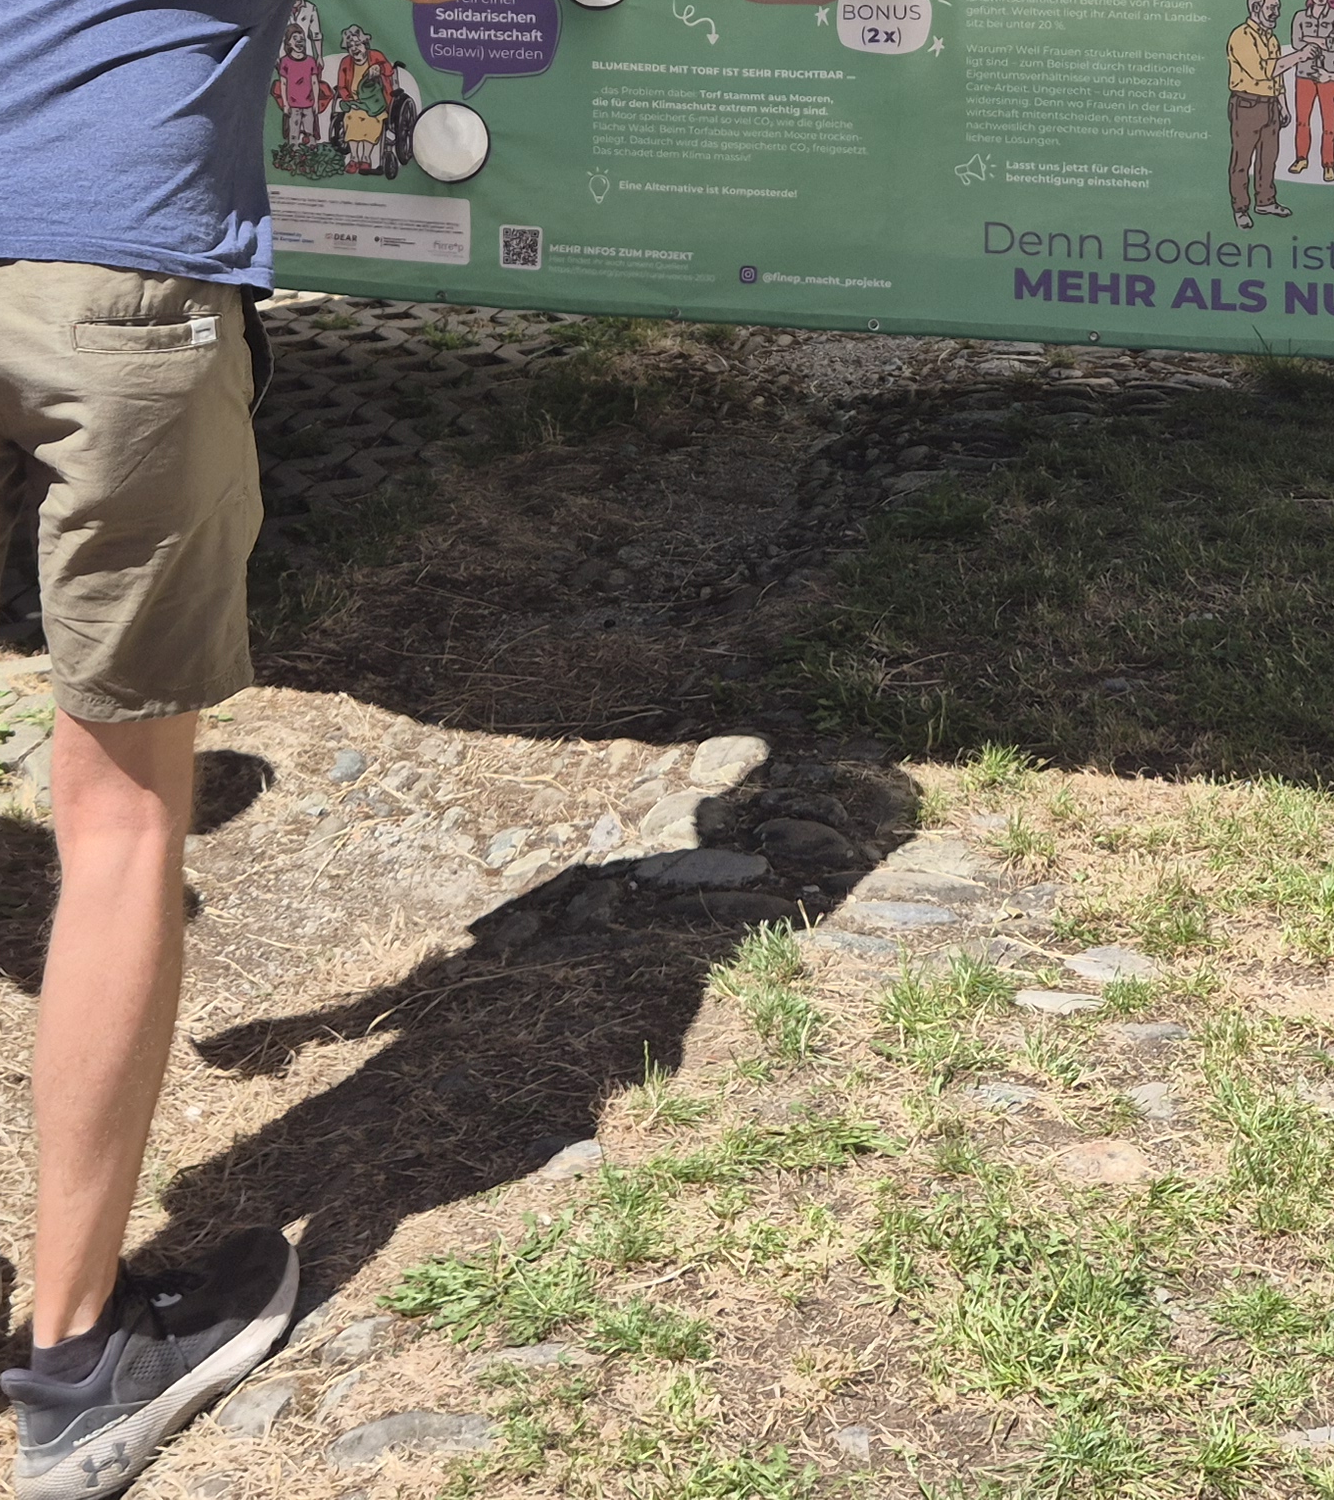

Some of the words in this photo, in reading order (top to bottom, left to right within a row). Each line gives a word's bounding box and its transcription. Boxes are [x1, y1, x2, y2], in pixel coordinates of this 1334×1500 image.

[435, 7, 536, 23] Solidarischen
[842, 3, 921, 20] BONUS
[429, 25, 543, 42] Landwirtschaft
[429, 43, 484, 60] (Solawi)
[487, 46, 543, 60] werden
[591, 60, 667, 73] BLUMENERDE
[668, 64, 689, 74] MIT
[690, 65, 720, 75] TORF
[722, 67, 739, 76] IST
[741, 67, 772, 78] SEHR
[774, 69, 844, 79] FRUCHTBAR
[698, 89, 722, 100] Torf
[723, 91, 766, 102] stammt
[767, 93, 787, 103] aus
[788, 93, 834, 105] Mooren,
[591, 97, 609, 108] die
[610, 97, 627, 108] für
[627, 98, 649, 108] den
[651, 100, 717, 112] Klimaschutz
[718, 103, 758, 113] extrem
[759, 103, 801, 117] wichtig
[802, 105, 829, 116] sind.
[1005, 160, 1036, 172] Lasst
[1037, 164, 1060, 173] uns
[1061, 161, 1089, 174] jetzt
[1091, 163, 1109, 174] für
[1110, 164, 1153, 175] Gleich-
[1005, 172, 1085, 187] berechtigung
[1086, 175, 1149, 188] einstehen!
[618, 180, 642, 191] Eine
[643, 181, 704, 194] Alternative
[705, 184, 719, 195] ist
[721, 185, 798, 198] Komposterde!
[333, 233, 358, 242] DEAR
[983, 221, 1103, 259] Denn
[1122, 228, 1272, 268] Boden
[761, 272, 892, 288] @finep_macht_projekte
[1013, 268, 1156, 307] MEHR
[1169, 277, 1267, 313] ALS
